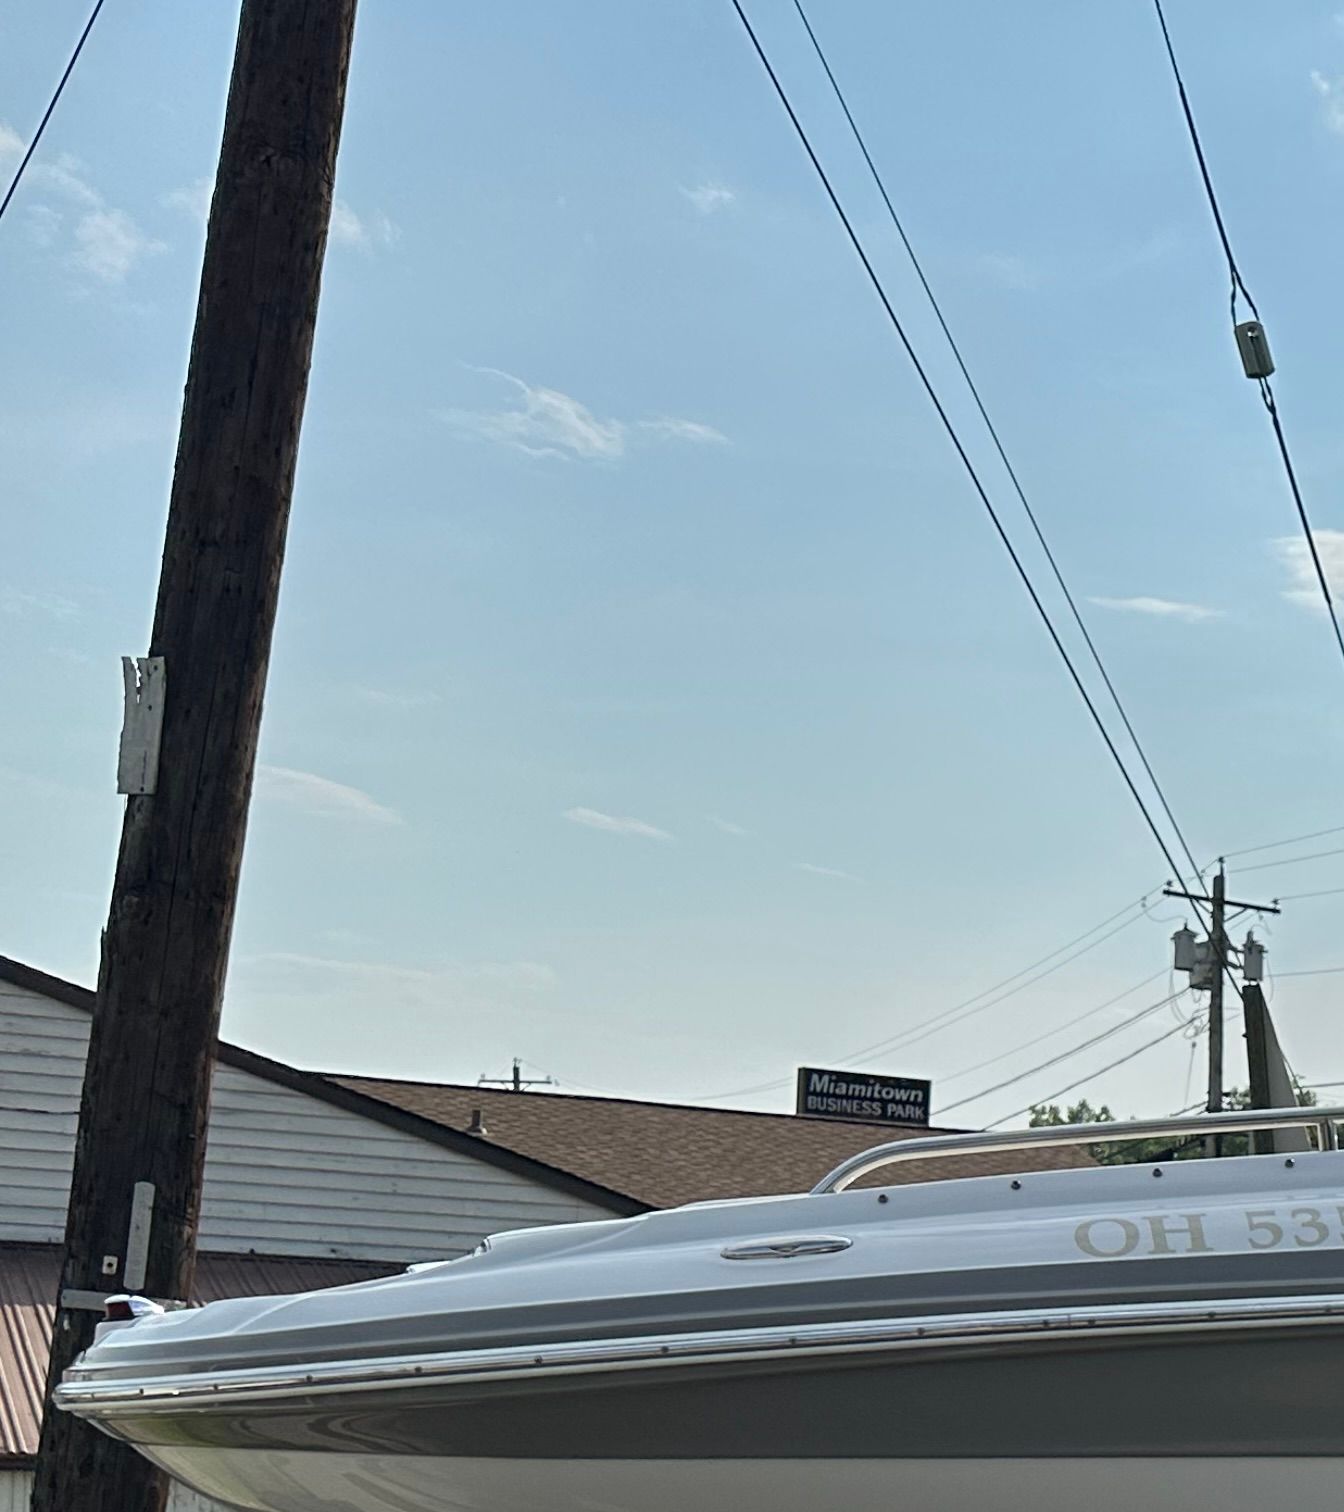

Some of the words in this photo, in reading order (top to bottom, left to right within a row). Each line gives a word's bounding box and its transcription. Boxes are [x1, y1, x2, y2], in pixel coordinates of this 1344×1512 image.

[809, 1073, 924, 1102] Miamitown
[807, 1095, 883, 1116] BUSINESS
[886, 1103, 925, 1120] PARK
[1074, 1212, 1216, 1258] OH
